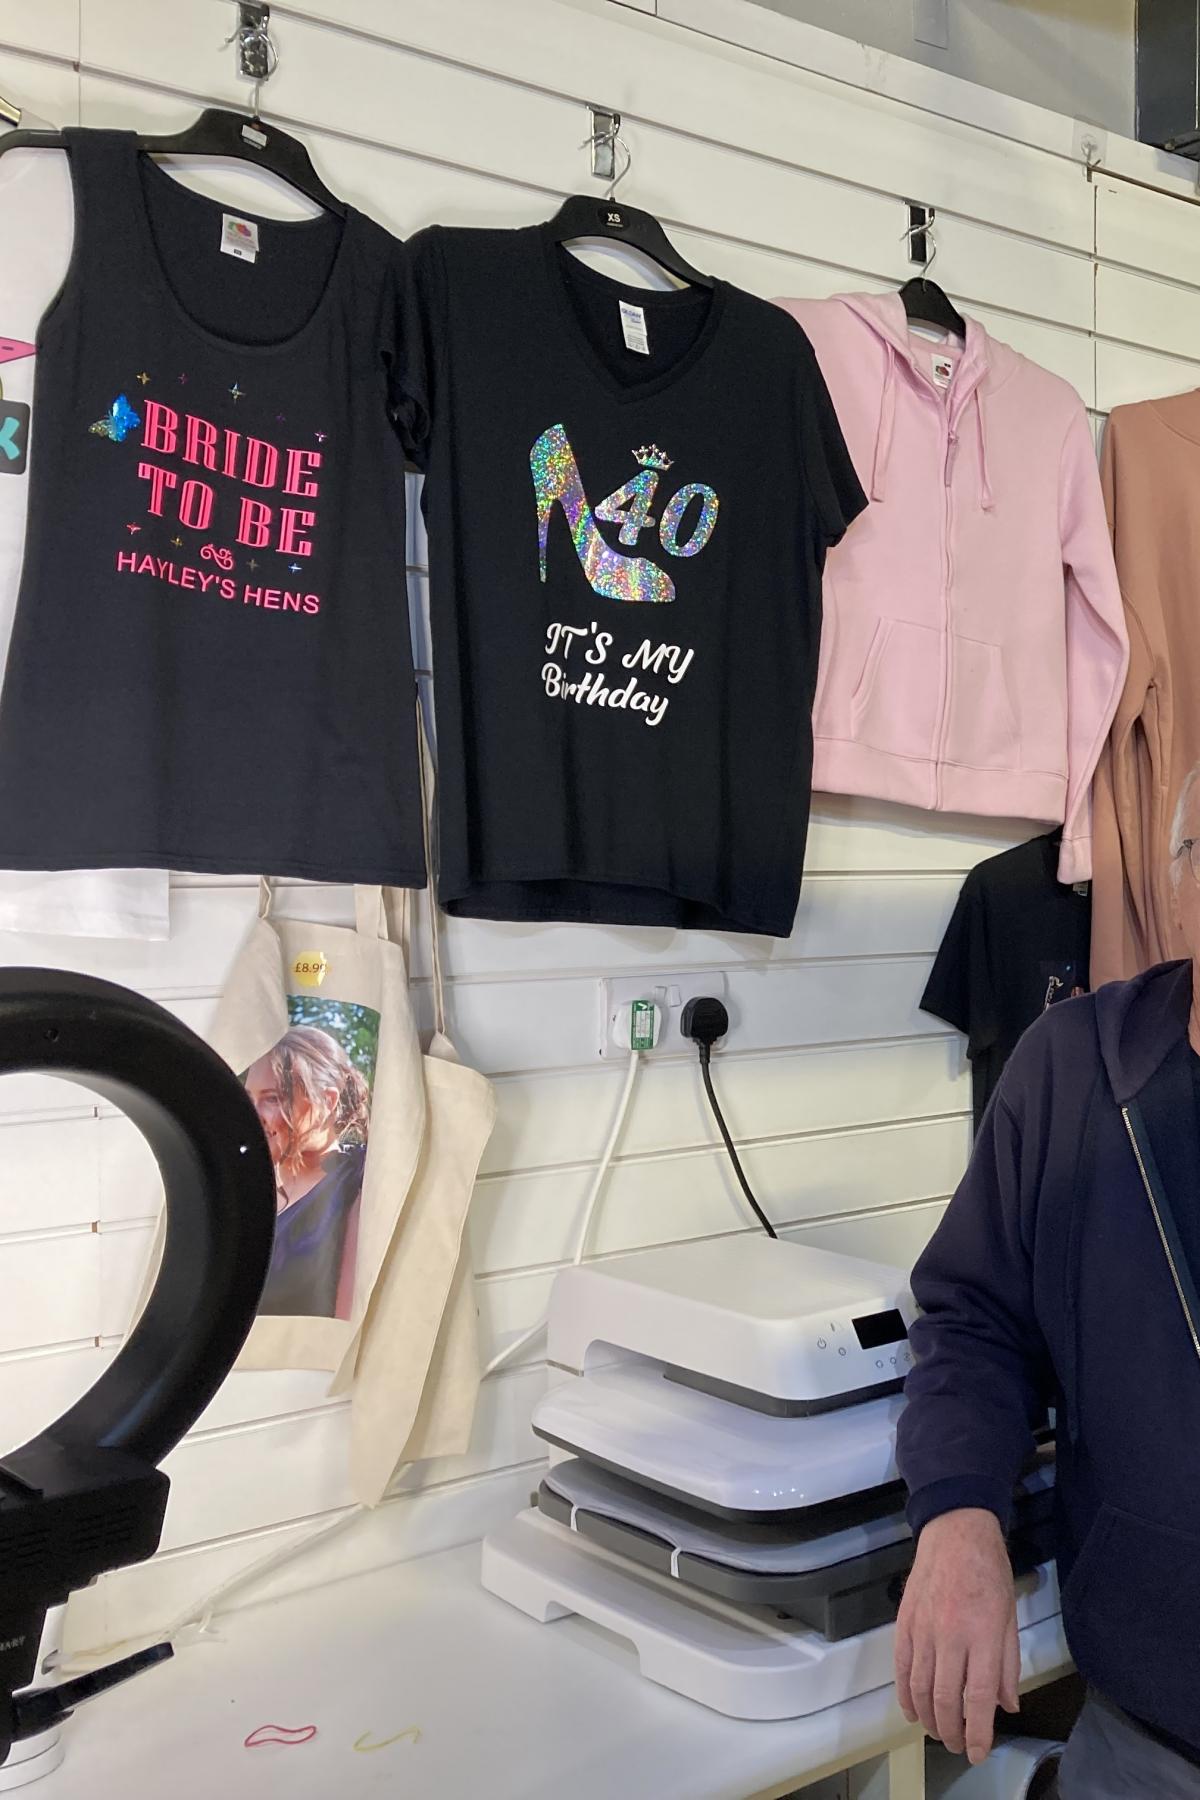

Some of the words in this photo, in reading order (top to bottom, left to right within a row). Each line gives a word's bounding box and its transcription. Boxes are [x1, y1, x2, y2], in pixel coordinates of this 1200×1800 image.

[607, 213, 621, 223] XS
[140, 399, 322, 498] BRIDE
[138, 462, 214, 530] TO
[235, 497, 316, 556] BE
[594, 469, 720, 558] 40
[116, 551, 236, 600] HAYLEY'S
[244, 585, 320, 614] HENS
[544, 621, 614, 665] IT'S
[621, 639, 695, 684] MY
[541, 662, 669, 726] Birthday
